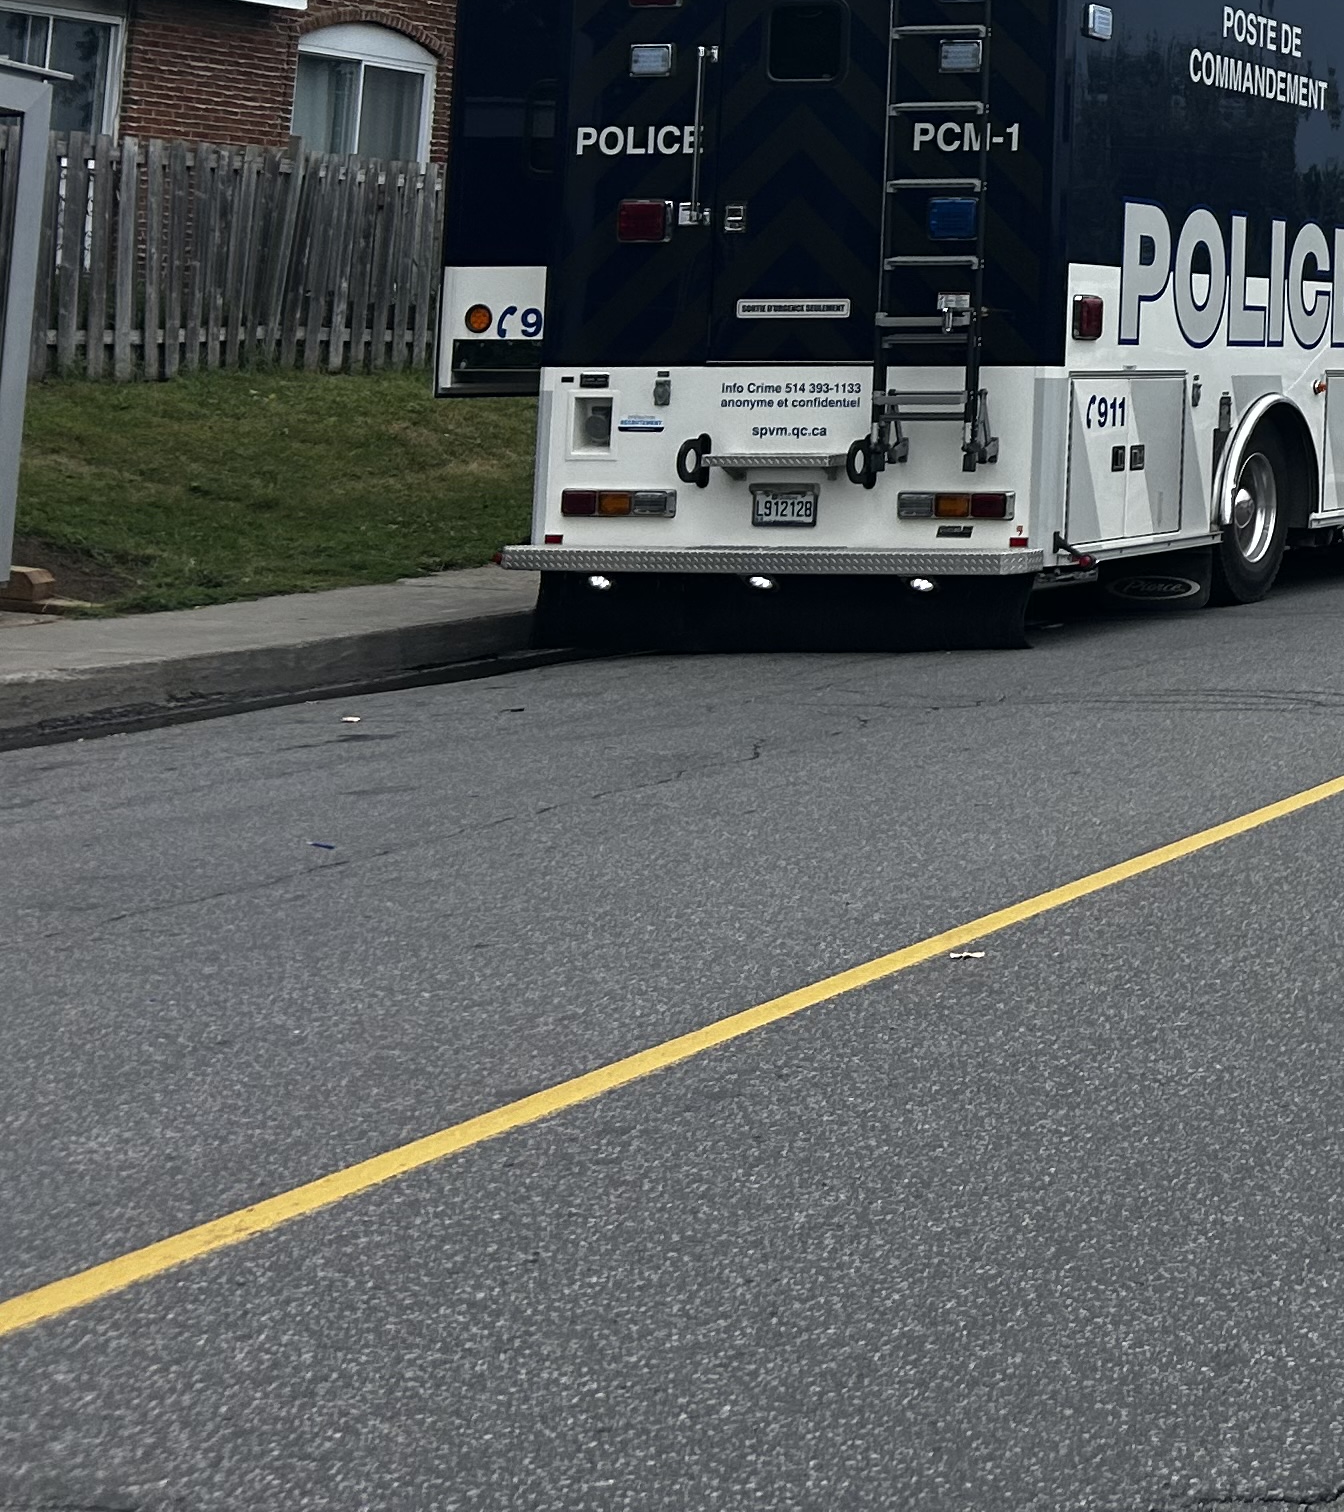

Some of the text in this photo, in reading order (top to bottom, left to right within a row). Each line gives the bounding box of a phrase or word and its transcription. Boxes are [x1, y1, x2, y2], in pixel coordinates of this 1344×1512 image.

[1222, 5, 1302, 58] POSTE DE
[1189, 48, 1328, 111] COMMANDEMENT
[575, 122, 1020, 156] POLICE PCM-1
[721, 383, 862, 394] Info Crime 514 393-1133
[721, 397, 861, 410] anonyme et confidentiel
[1097, 396, 1126, 428] 911
[752, 426, 827, 439] spvm.qc.ca
[756, 500, 813, 518] L912128
